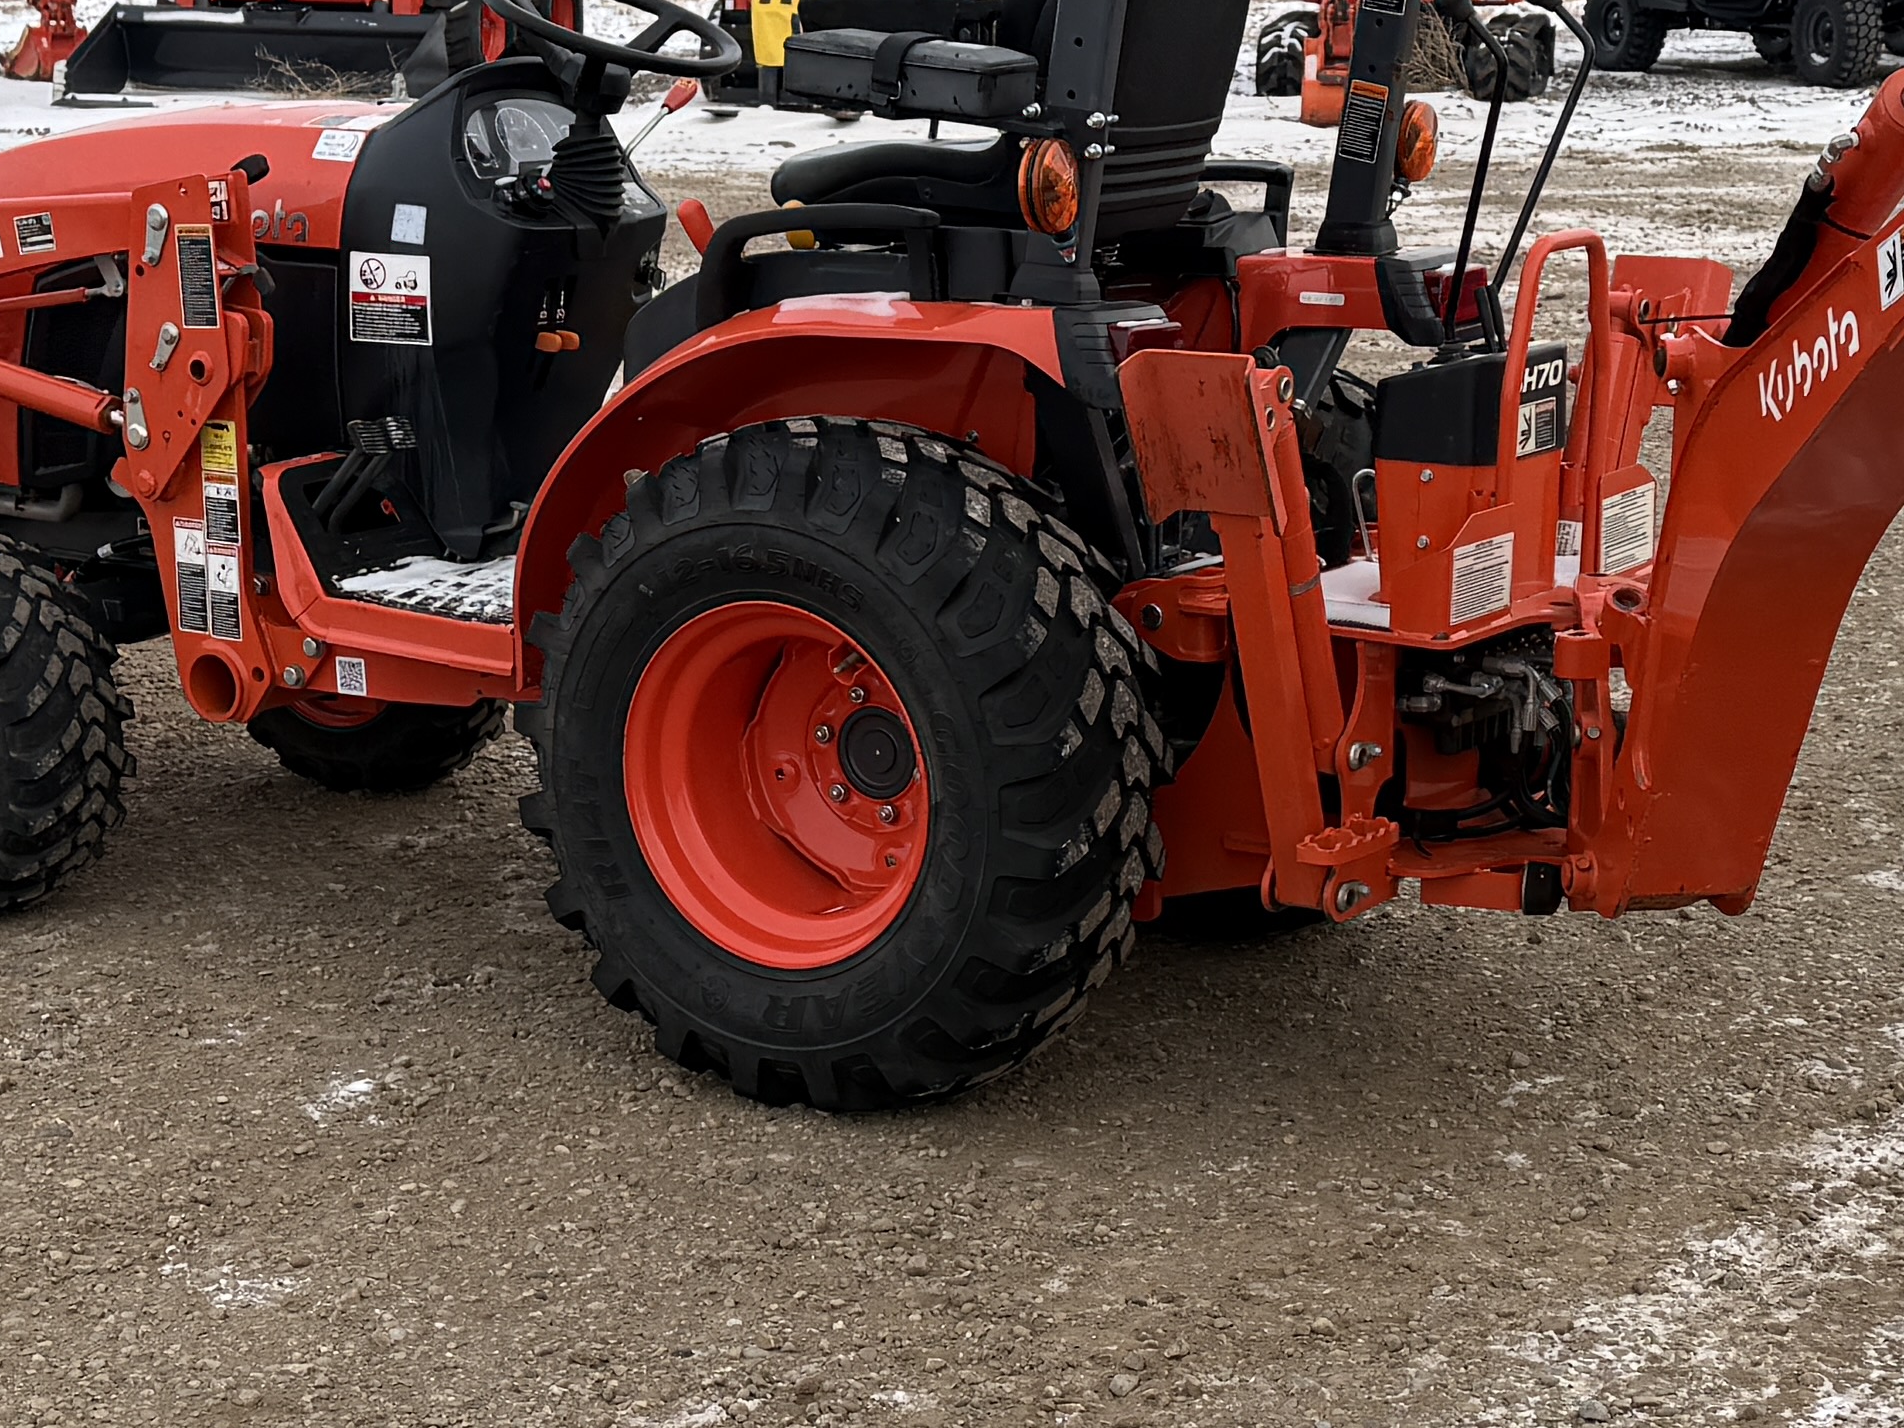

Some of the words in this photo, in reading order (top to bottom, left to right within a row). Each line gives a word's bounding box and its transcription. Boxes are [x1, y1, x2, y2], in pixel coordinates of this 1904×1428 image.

[251, 198, 309, 242] ota
[1520, 358, 1564, 393] H70
[1758, 306, 1860, 422] Kubota
